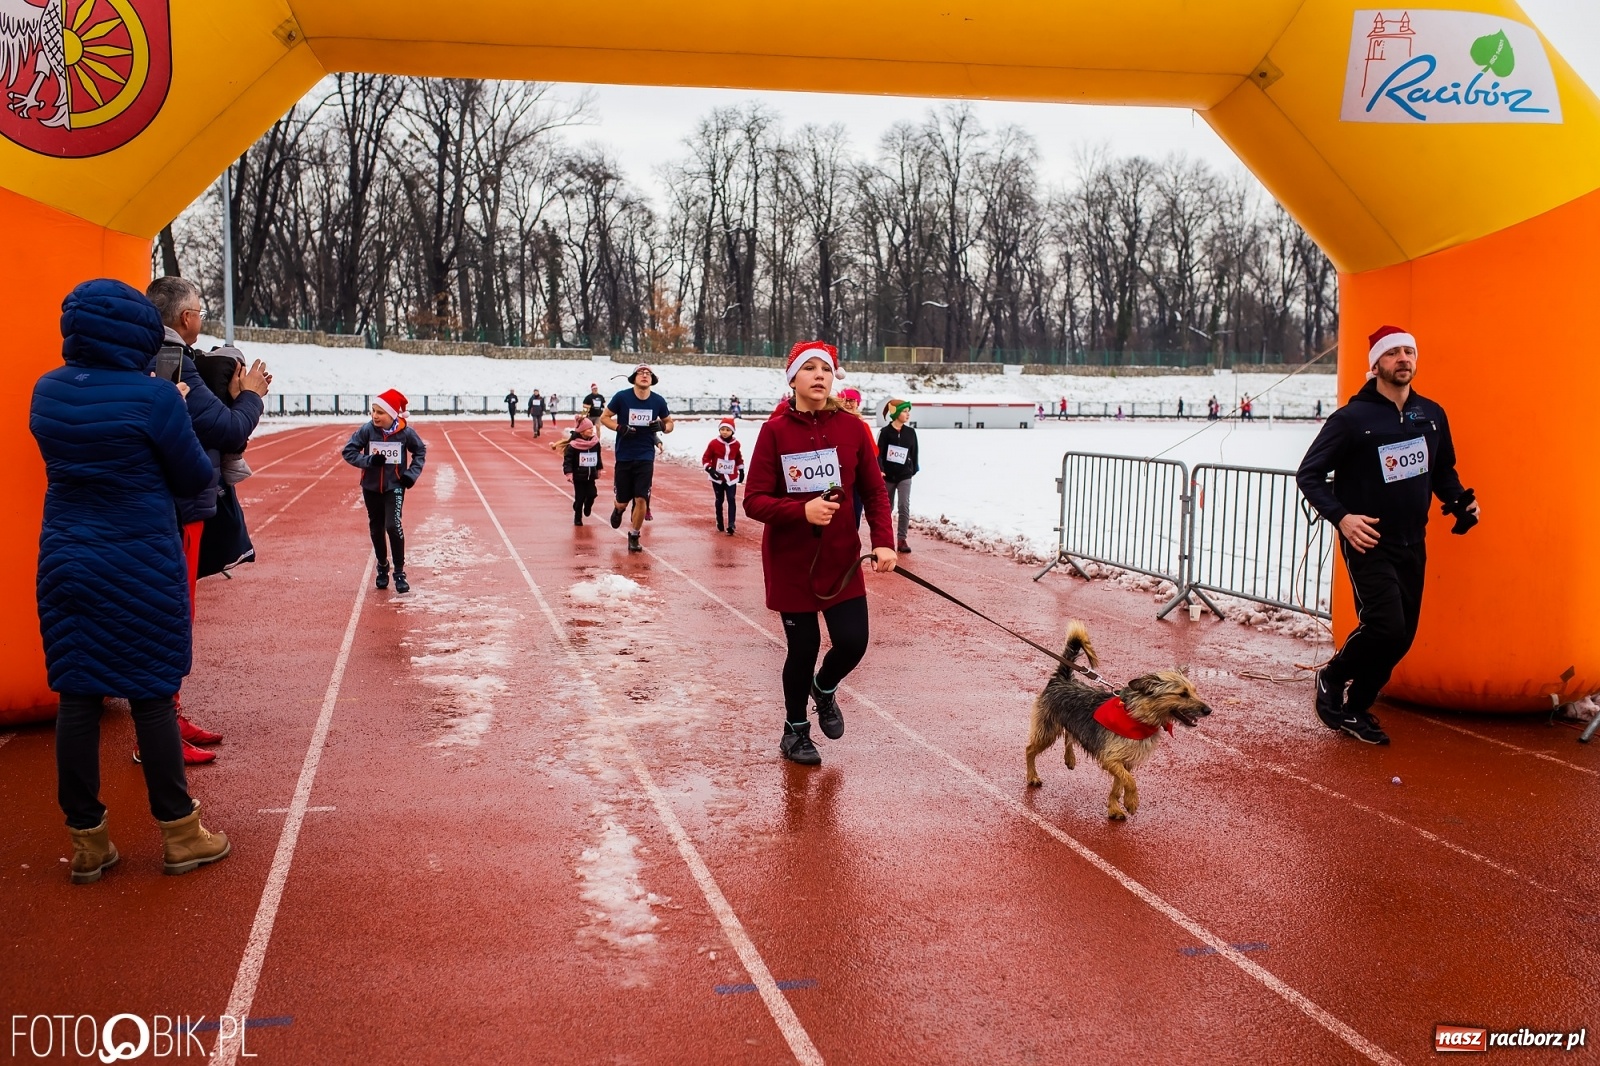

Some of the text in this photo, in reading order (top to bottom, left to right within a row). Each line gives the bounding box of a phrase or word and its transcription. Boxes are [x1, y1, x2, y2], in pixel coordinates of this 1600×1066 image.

[1366, 54, 1550, 121] Racibórz
[74, 373, 90, 381] 4F
[1399, 450, 1425, 467] 039
[803, 463, 835, 480] 040
